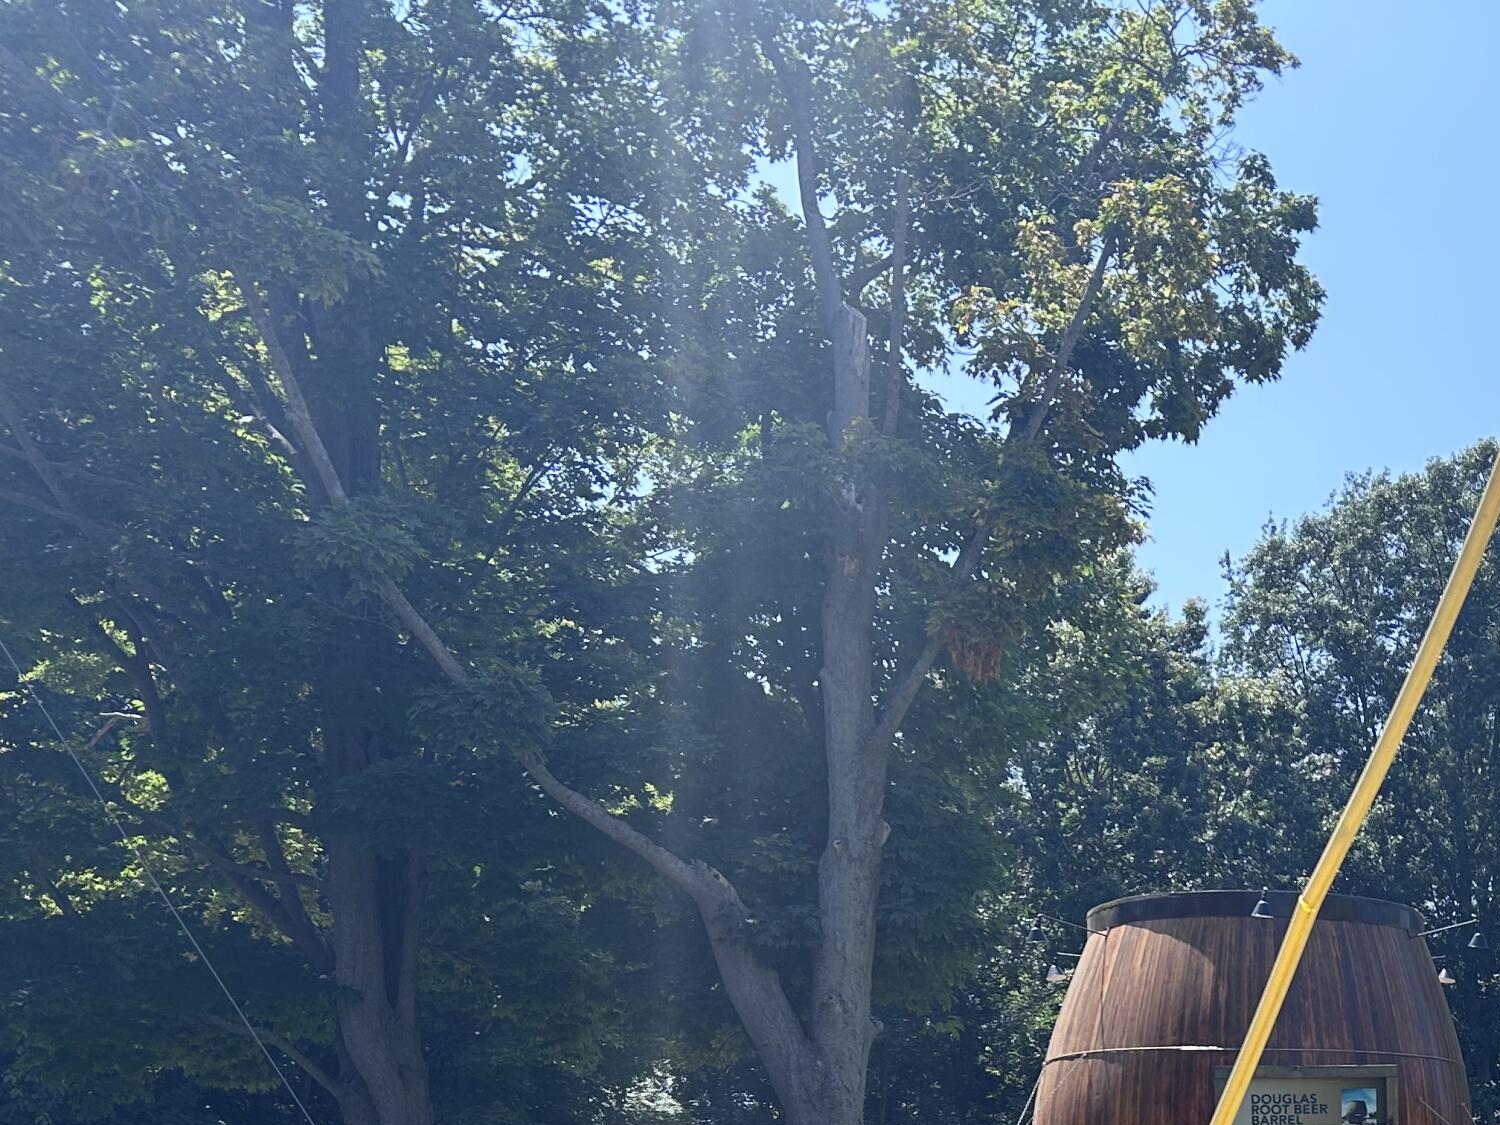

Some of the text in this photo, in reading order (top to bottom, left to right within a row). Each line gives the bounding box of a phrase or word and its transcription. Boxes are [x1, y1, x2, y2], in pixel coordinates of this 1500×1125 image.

[1251, 1094, 1318, 1104] DOUGLAS
[1251, 1104, 1328, 1115] ROOT BEER
[1251, 1115, 1303, 1125] BARREL
